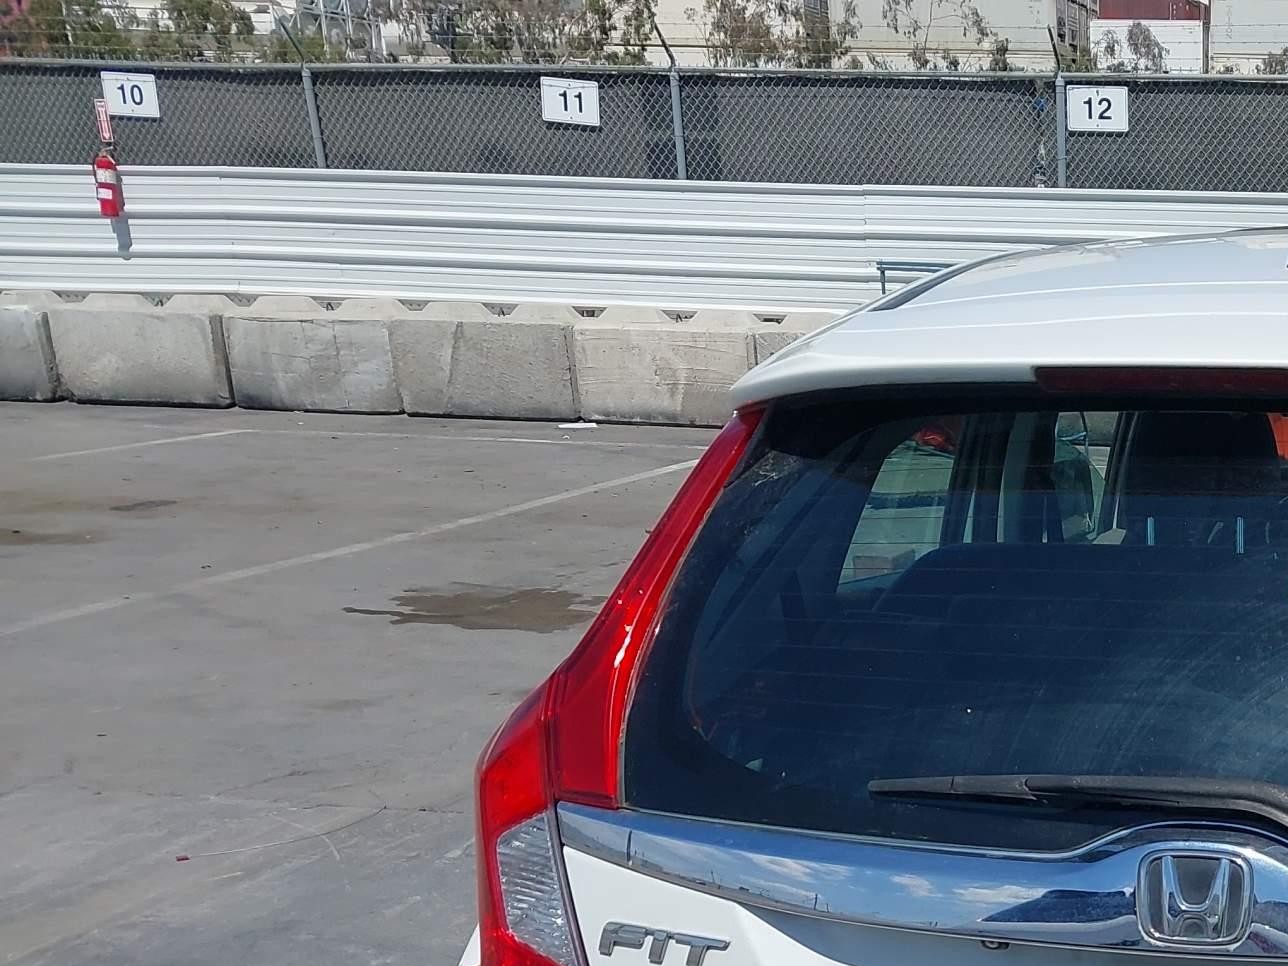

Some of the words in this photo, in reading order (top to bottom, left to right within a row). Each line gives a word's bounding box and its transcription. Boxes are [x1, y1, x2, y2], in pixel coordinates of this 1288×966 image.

[116, 83, 144, 106] 10
[558, 90, 583, 114] 11
[1083, 97, 1113, 120] 12
